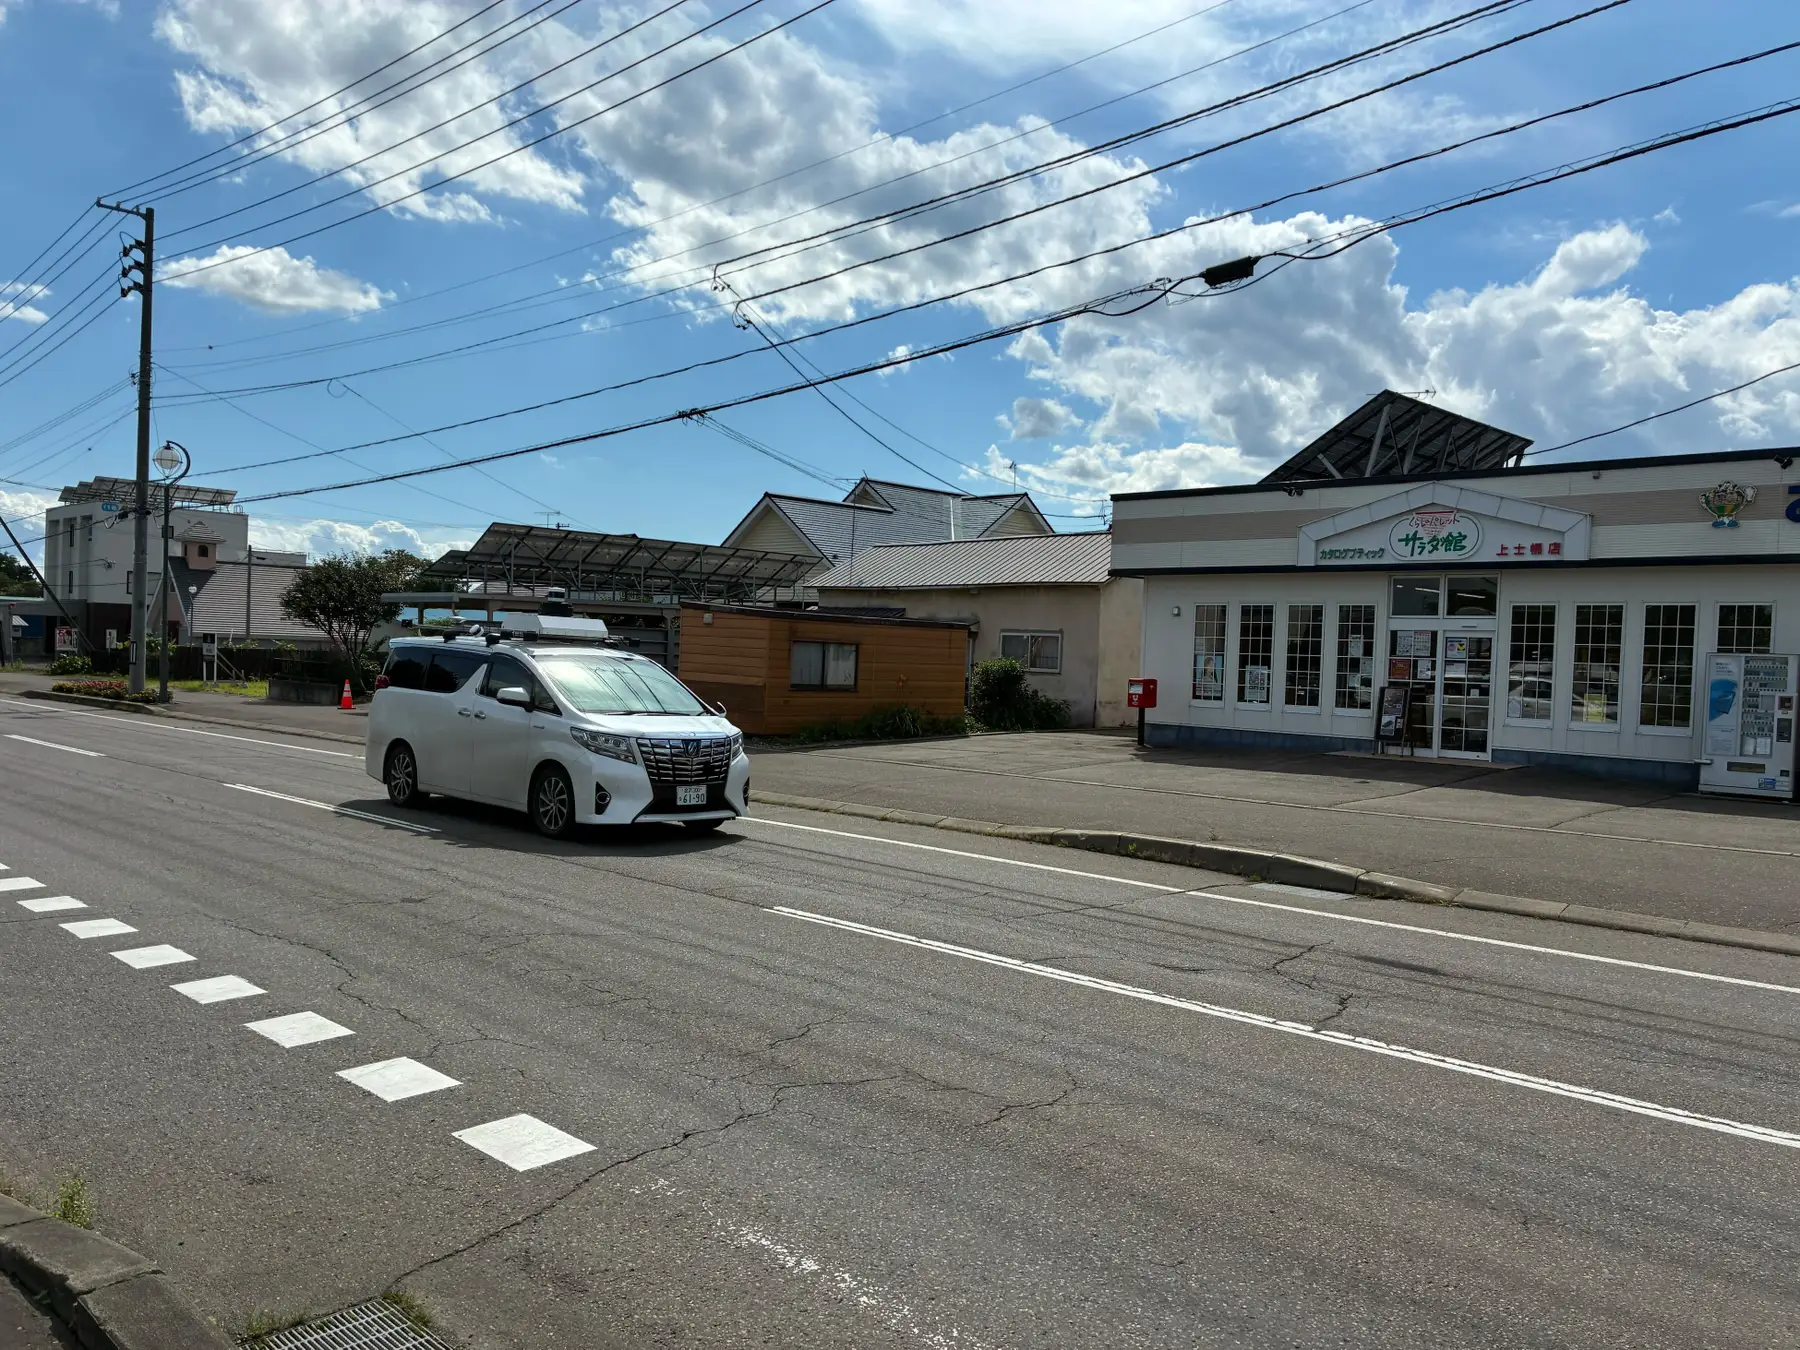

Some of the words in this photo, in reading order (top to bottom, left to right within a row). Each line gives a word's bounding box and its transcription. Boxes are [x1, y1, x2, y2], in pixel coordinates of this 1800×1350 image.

[1398, 530, 1467, 557] サラダ館
[1496, 541, 1561, 556] 上士幌店
